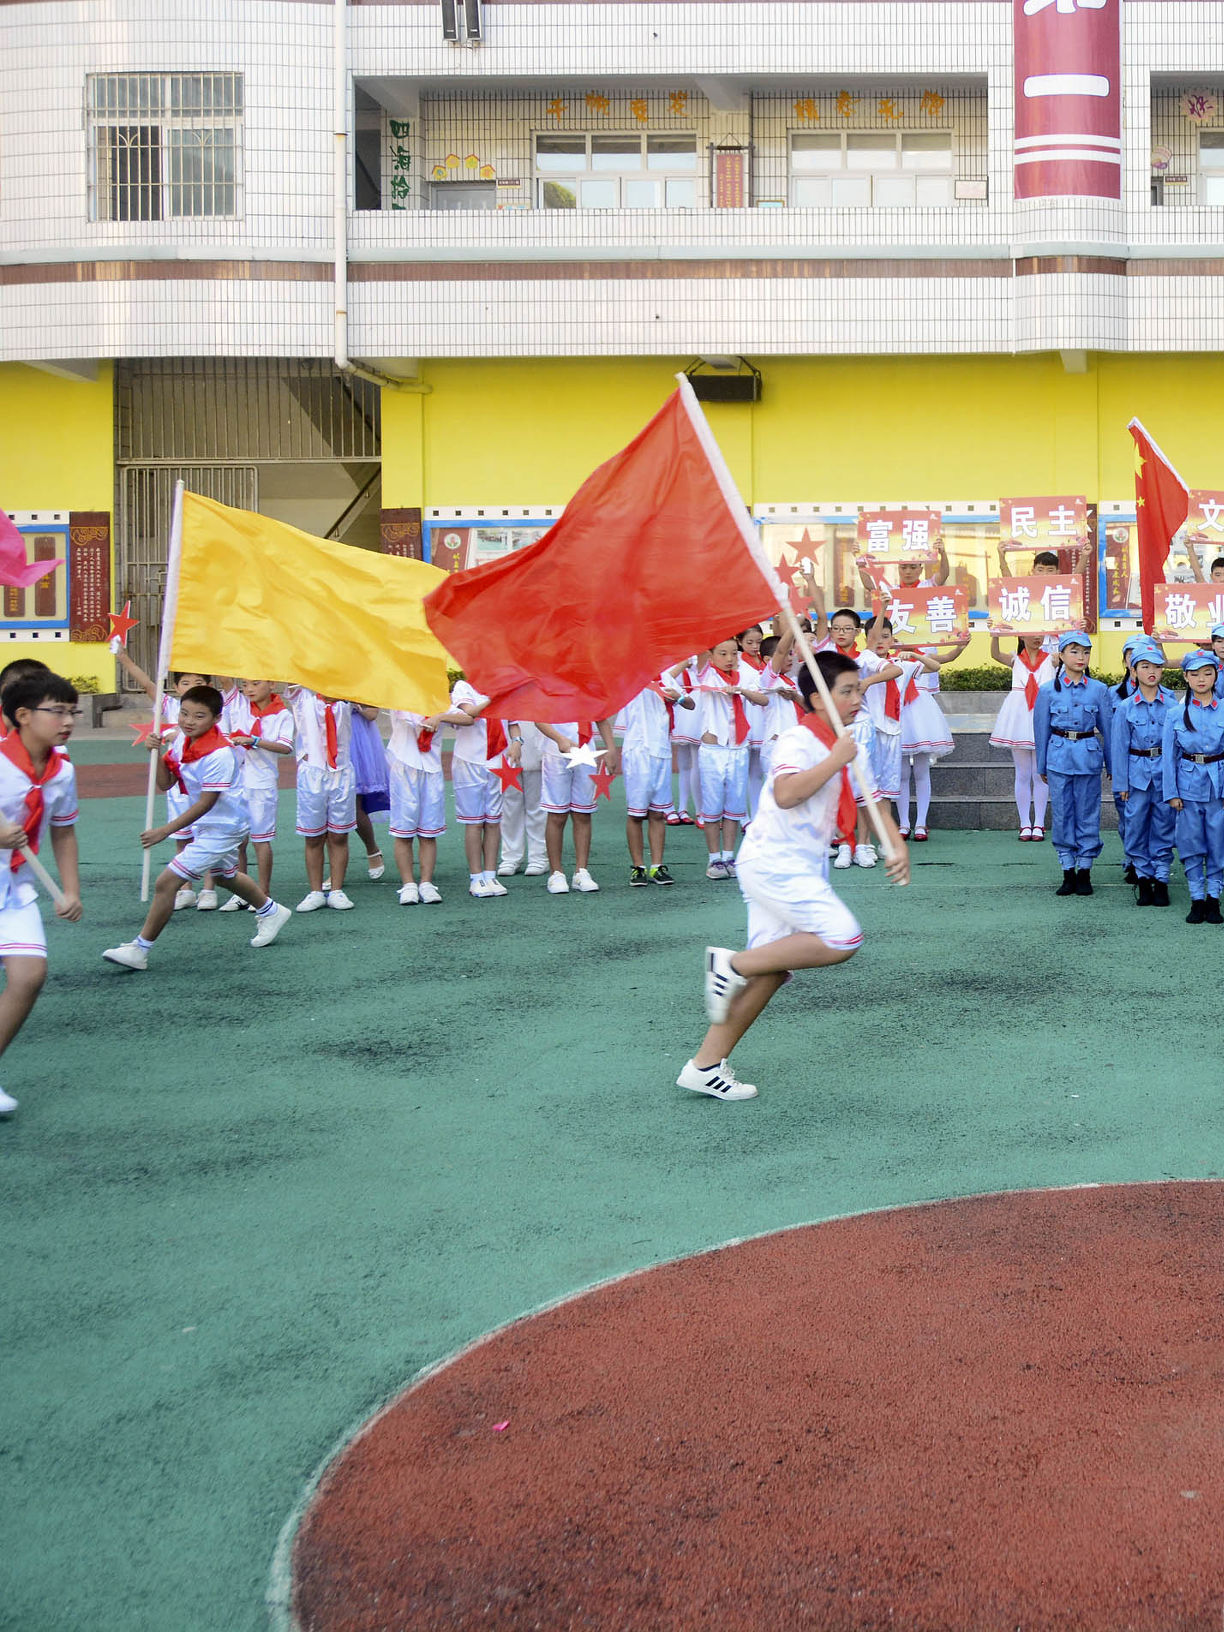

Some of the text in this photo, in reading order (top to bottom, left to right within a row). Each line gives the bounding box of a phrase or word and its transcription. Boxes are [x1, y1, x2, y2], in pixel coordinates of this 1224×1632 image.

[866, 519, 930, 553] 富强
[1010, 504, 1078, 538] 民主
[886, 596, 957, 635] 友善
[997, 583, 1073, 622] 诚信
